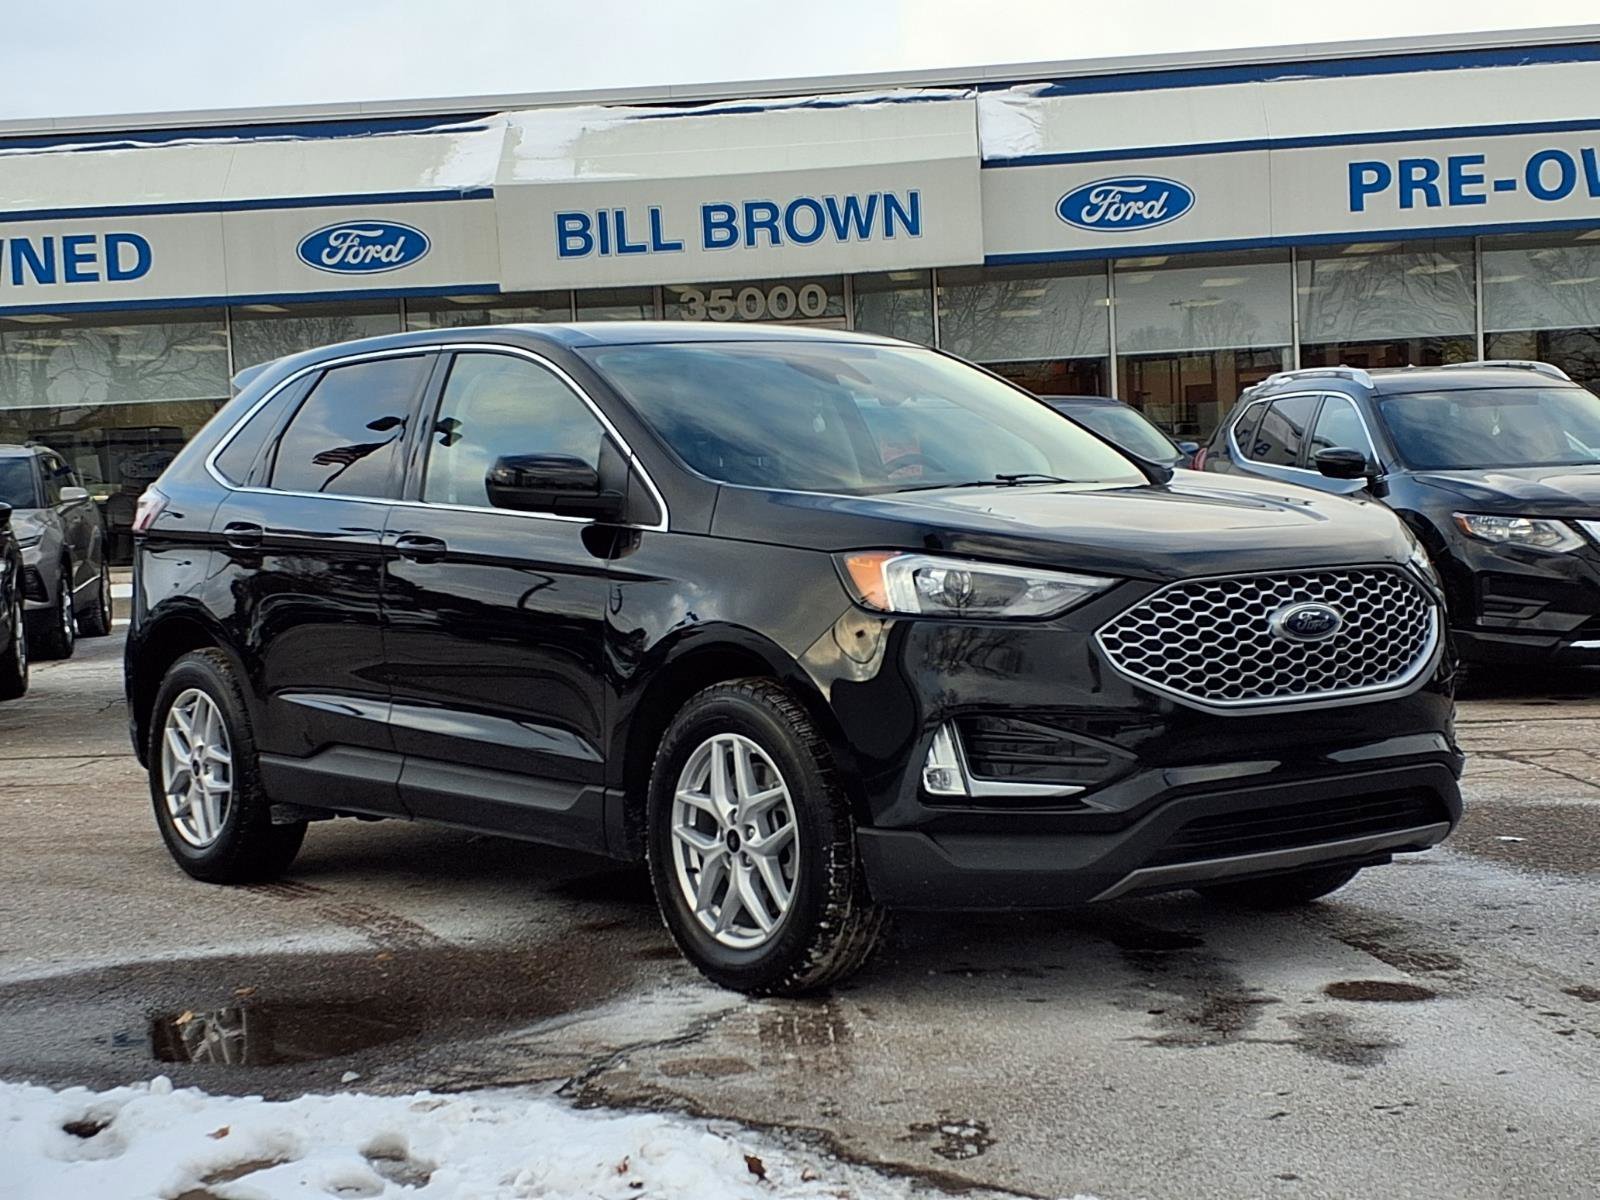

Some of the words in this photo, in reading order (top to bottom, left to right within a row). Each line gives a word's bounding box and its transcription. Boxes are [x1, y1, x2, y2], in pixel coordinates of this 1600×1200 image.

[1348, 147, 1600, 213] PRE-O
[555, 205, 684, 259] BILL
[701, 189, 922, 250] BROWN
[1081, 184, 1170, 224] Ford
[0, 232, 153, 286] NED
[321, 229, 406, 265] Ford
[679, 283, 828, 322] 35000
